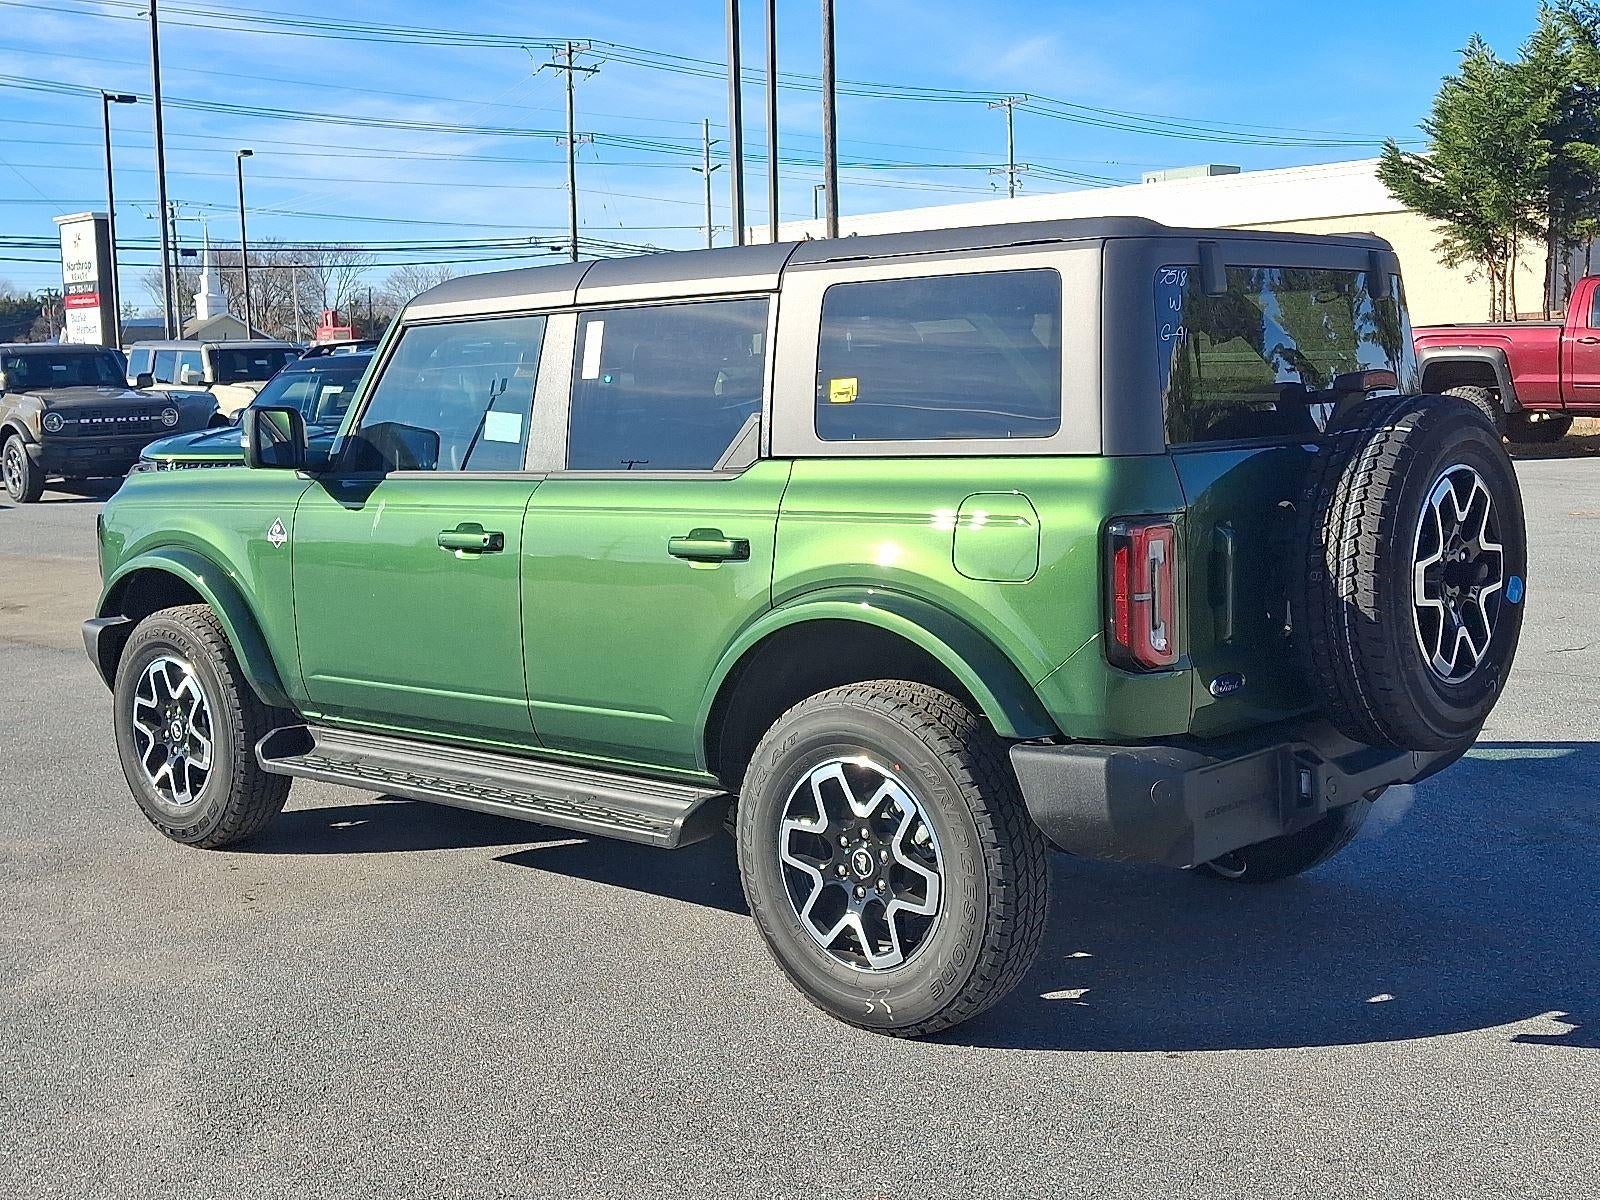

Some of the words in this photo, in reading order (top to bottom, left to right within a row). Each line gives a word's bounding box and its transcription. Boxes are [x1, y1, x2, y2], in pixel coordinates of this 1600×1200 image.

[1160, 268, 1188, 287] 7518
[1169, 294, 1182, 312] W
[80, 416, 150, 424] BRONCO
[916, 762, 978, 1000] BRIDGESTONE
